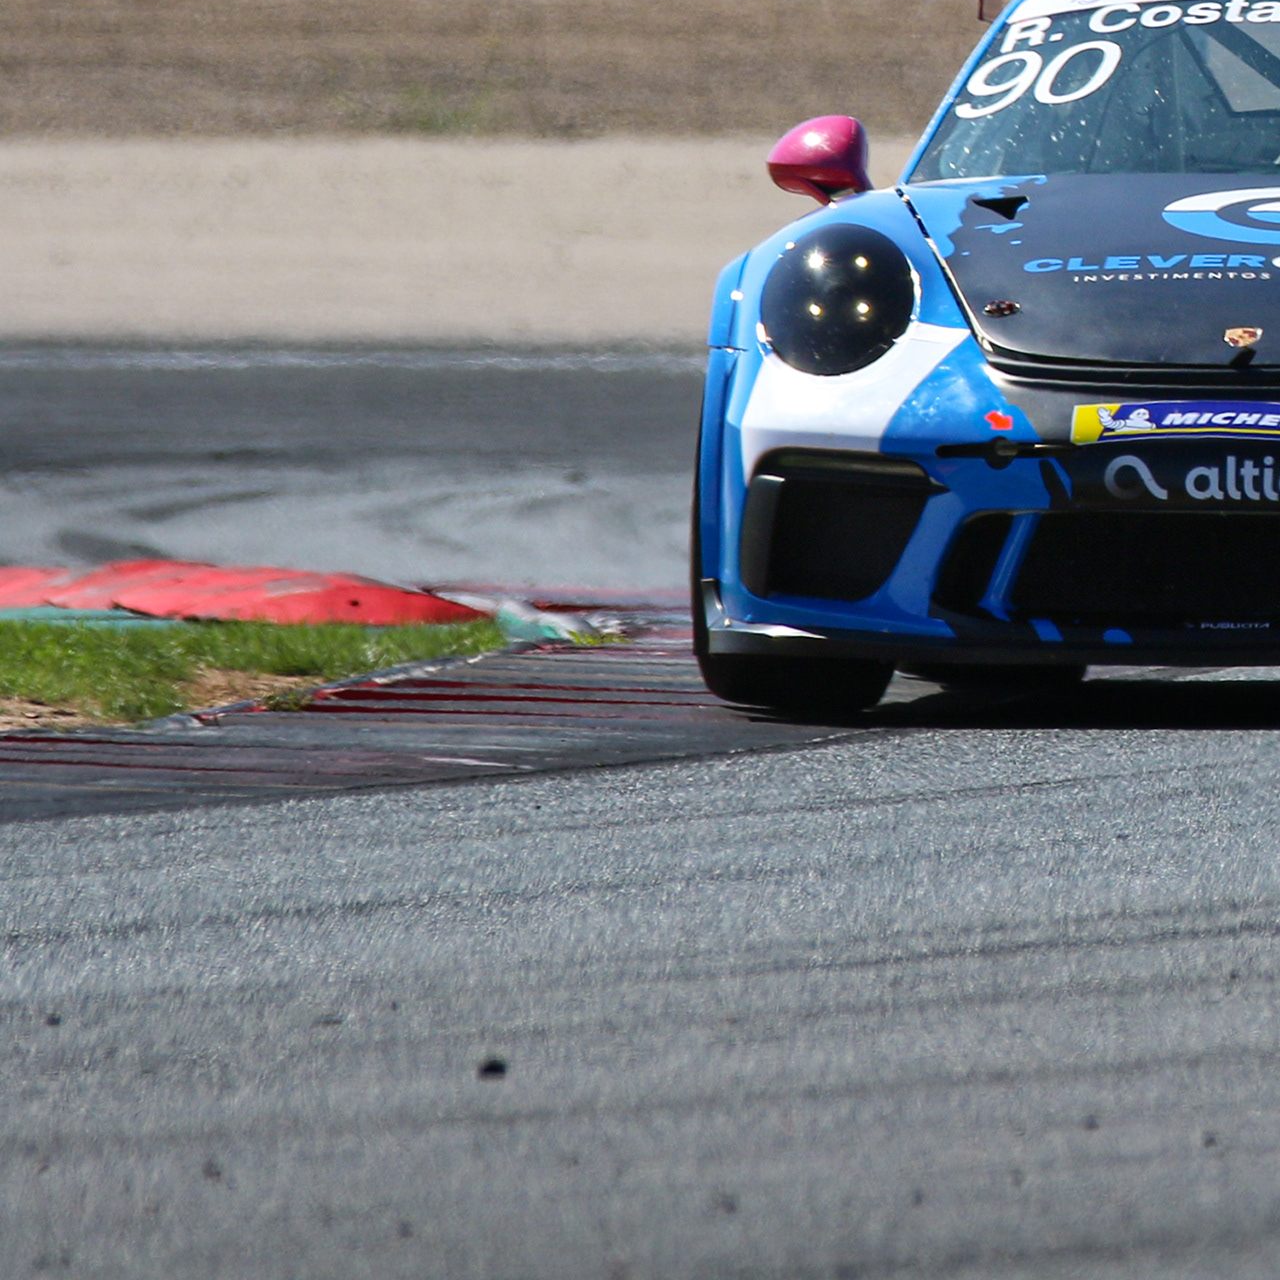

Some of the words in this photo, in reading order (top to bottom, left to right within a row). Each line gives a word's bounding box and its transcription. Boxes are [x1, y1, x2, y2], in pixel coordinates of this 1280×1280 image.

[1000, 16, 1064, 53] R.
[954, 40, 1122, 118] 90
[1073, 272, 1272, 283] INVESTIMENTOS
